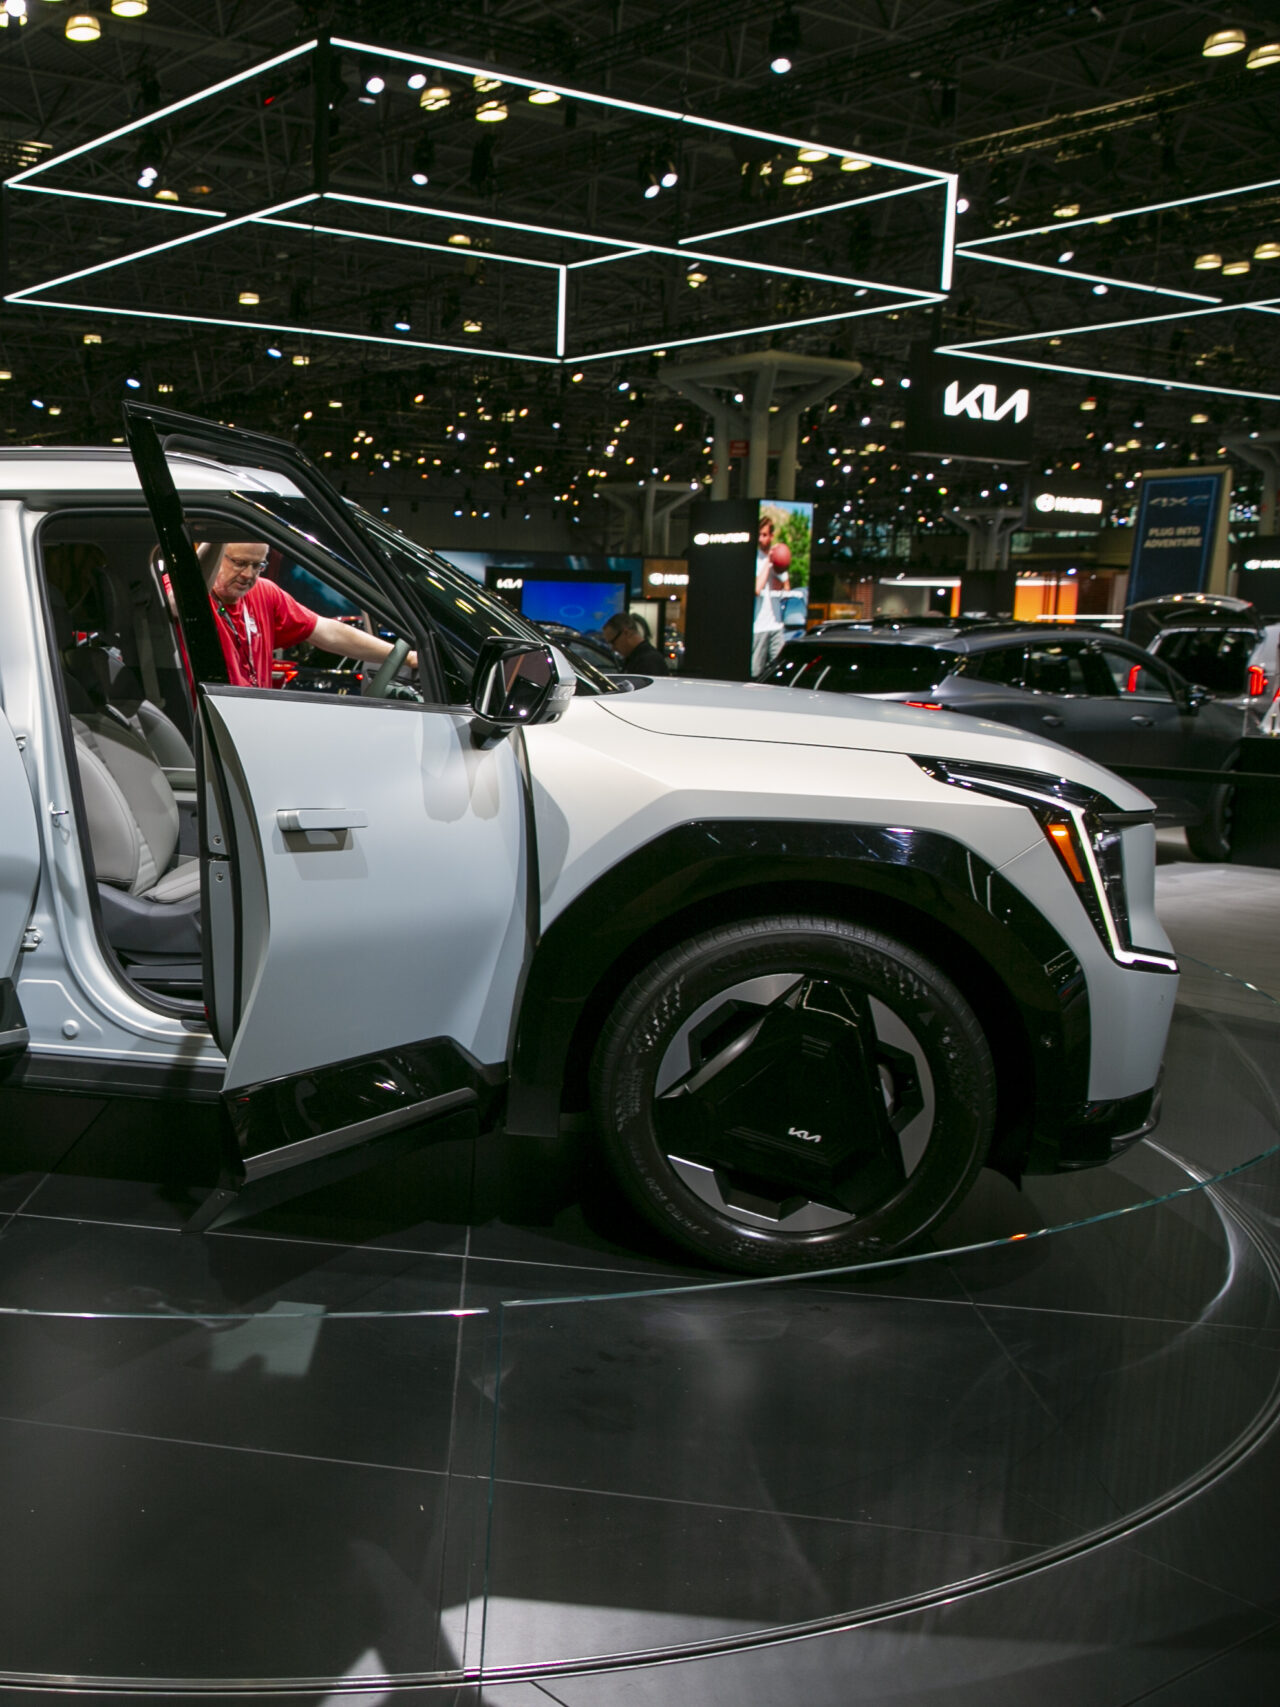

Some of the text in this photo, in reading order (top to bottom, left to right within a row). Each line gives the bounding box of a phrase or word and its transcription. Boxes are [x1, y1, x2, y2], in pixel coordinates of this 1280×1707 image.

[944, 380, 1029, 424] KIA
[1147, 527, 1175, 537] PLUG
[1144, 537, 1204, 549] ADVENTURE
[496, 578, 523, 589] KIA
[788, 1126, 821, 1144] KIA
